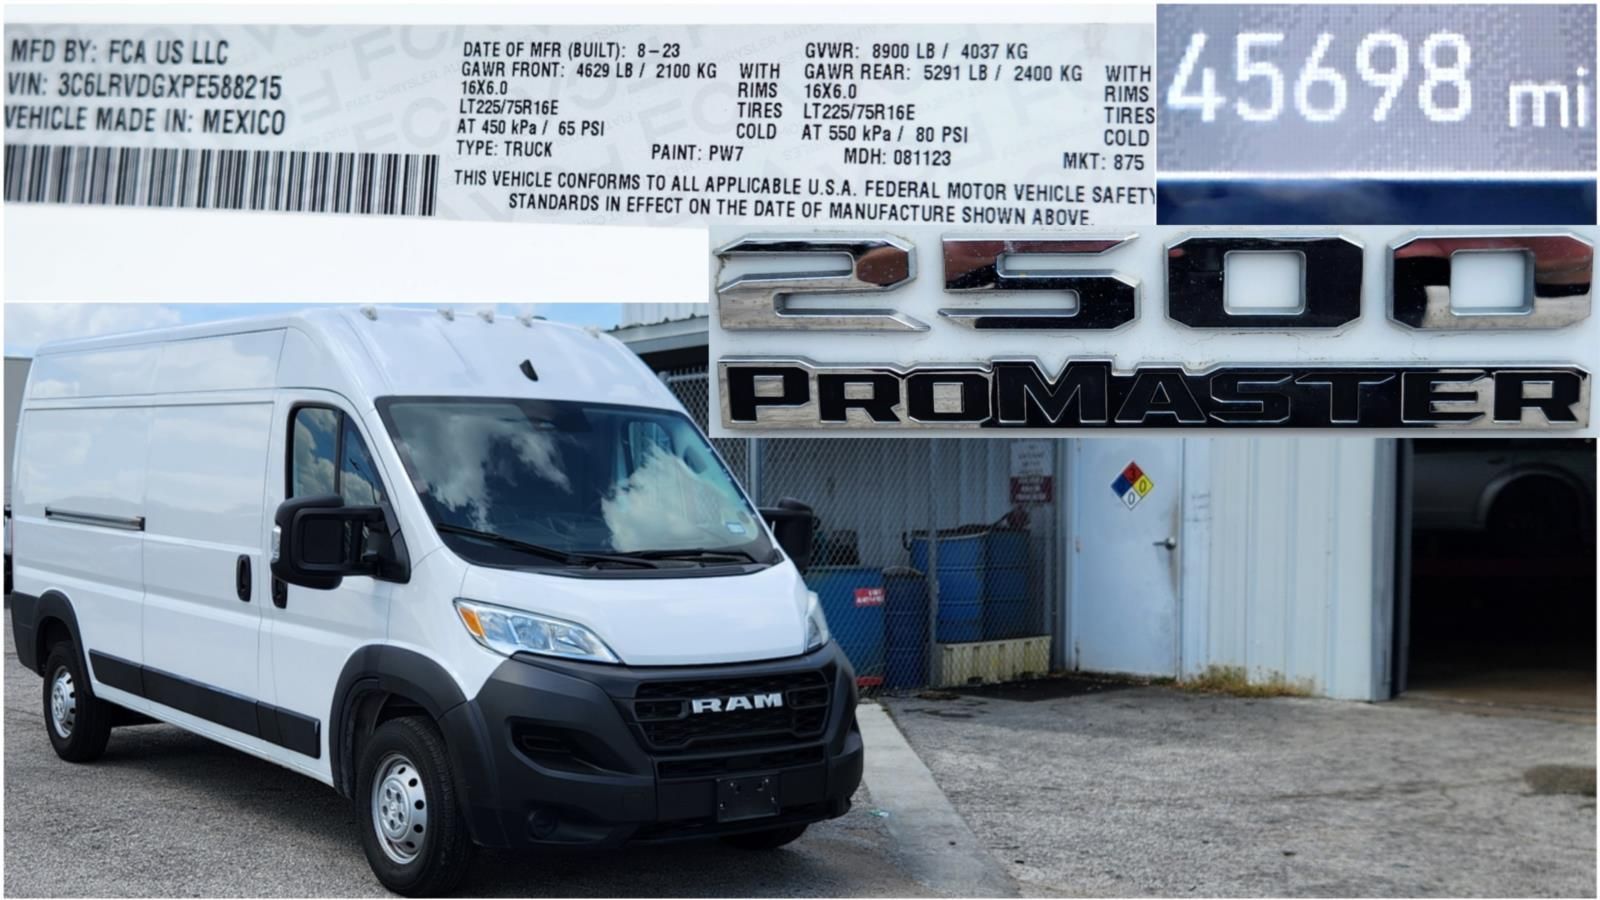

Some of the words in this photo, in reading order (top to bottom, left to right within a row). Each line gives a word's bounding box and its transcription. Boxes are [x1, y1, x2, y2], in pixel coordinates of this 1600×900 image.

[11, 39, 55, 62] MFD
[64, 39, 96, 63] BY:
[109, 40, 145, 64] FCA
[156, 40, 183, 64] US
[192, 40, 228, 65] LLC
[464, 42, 500, 57] DATE
[506, 42, 524, 57] OF
[531, 42, 561, 57] MFR
[568, 42, 625, 61] (BUILT):
[806, 42, 859, 58] GVWR:
[873, 43, 909, 59] 8900
[917, 43, 935, 59] LB
[942, 43, 948, 59] /
[961, 44, 999, 59] 4037
[1007, 43, 1027, 59] KG
[462, 61, 505, 77] GAWR
[512, 62, 564, 77] FRONT:
[577, 63, 609, 77] 4629
[616, 62, 633, 78] LB
[639, 63, 645, 78] /
[656, 63, 690, 78] 2100
[697, 63, 716, 78] KG
[740, 63, 780, 79] WITH
[805, 64, 853, 79] GAWR
[861, 64, 911, 80] REAR:
[924, 65, 959, 80] 5291
[969, 64, 987, 80] LB
[995, 65, 1001, 80] /
[1014, 66, 1052, 81] 2400
[1061, 65, 1082, 81] KG
[1106, 65, 1151, 82] WITH
[8, 72, 47, 95] VIN:
[58, 72, 281, 100] 3C6LRVDGXPE588215
[462, 80, 507, 95] 16X6.0
[1167, 31, 1472, 123] 45698
[1508, 66, 1590, 128] mi
[738, 82, 777, 98] RIMS
[805, 83, 856, 99] 16X6.0
[1105, 85, 1149, 102] RIMS
[460, 99, 558, 115] LT225/75R16E
[737, 102, 782, 118] TIRES
[804, 103, 915, 120] LT225/75R16E
[1104, 107, 1155, 124] TIRES
[5, 105, 87, 130] VEHICLE
[96, 107, 155, 132] MADE
[164, 109, 192, 132] IN:
[203, 109, 285, 135] MEXICO
[457, 119, 476, 133] AT
[482, 120, 506, 134] 450
[512, 119, 536, 135] kPa
[542, 120, 548, 135] /
[559, 121, 575, 136] 65
[581, 121, 604, 136] PSI
[736, 123, 776, 139] COLD
[802, 124, 822, 140] AT
[829, 125, 856, 141] 550
[863, 125, 891, 141] kPa
[897, 126, 904, 142] /
[916, 127, 934, 142] 80
[942, 126, 967, 143] PSI
[1104, 129, 1149, 146] COLD
[457, 140, 498, 156] TYPE:
[504, 141, 552, 157] TRUCK
[652, 144, 701, 160] PAINT:
[709, 145, 743, 161] PW7
[844, 148, 886, 164] MDH:
[894, 149, 951, 166] 081123
[1064, 152, 1105, 169] MKT:
[1114, 154, 1144, 170] 875
[455, 170, 486, 185] THIS
[493, 171, 552, 187] VEHICLE
[558, 172, 640, 190] CONFORMS
[647, 175, 665, 191] TO
[671, 175, 699, 192] ALL
[705, 176, 801, 195] APPLICABLE
[809, 179, 856, 196] U.S.A.
[865, 180, 940, 198] FEDERAL
[948, 182, 1006, 200] MOTOR
[1014, 184, 1084, 203] VEHICLE
[509, 193, 599, 211] STANDARDS
[606, 196, 620, 211] IN
[627, 196, 683, 213] EFFECT
[689, 198, 710, 214] ON
[717, 199, 747, 216] THE
[754, 200, 795, 217] DATE
[802, 202, 822, 218] OF
[830, 202, 955, 222] MANUFACTURE
[962, 206, 1025, 224] SHOWN
[713, 232, 1594, 331] 2500
[1139, 479, 1147, 494] 0
[1128, 491, 1136, 505] 0
[692, 692, 783, 714] RAM
